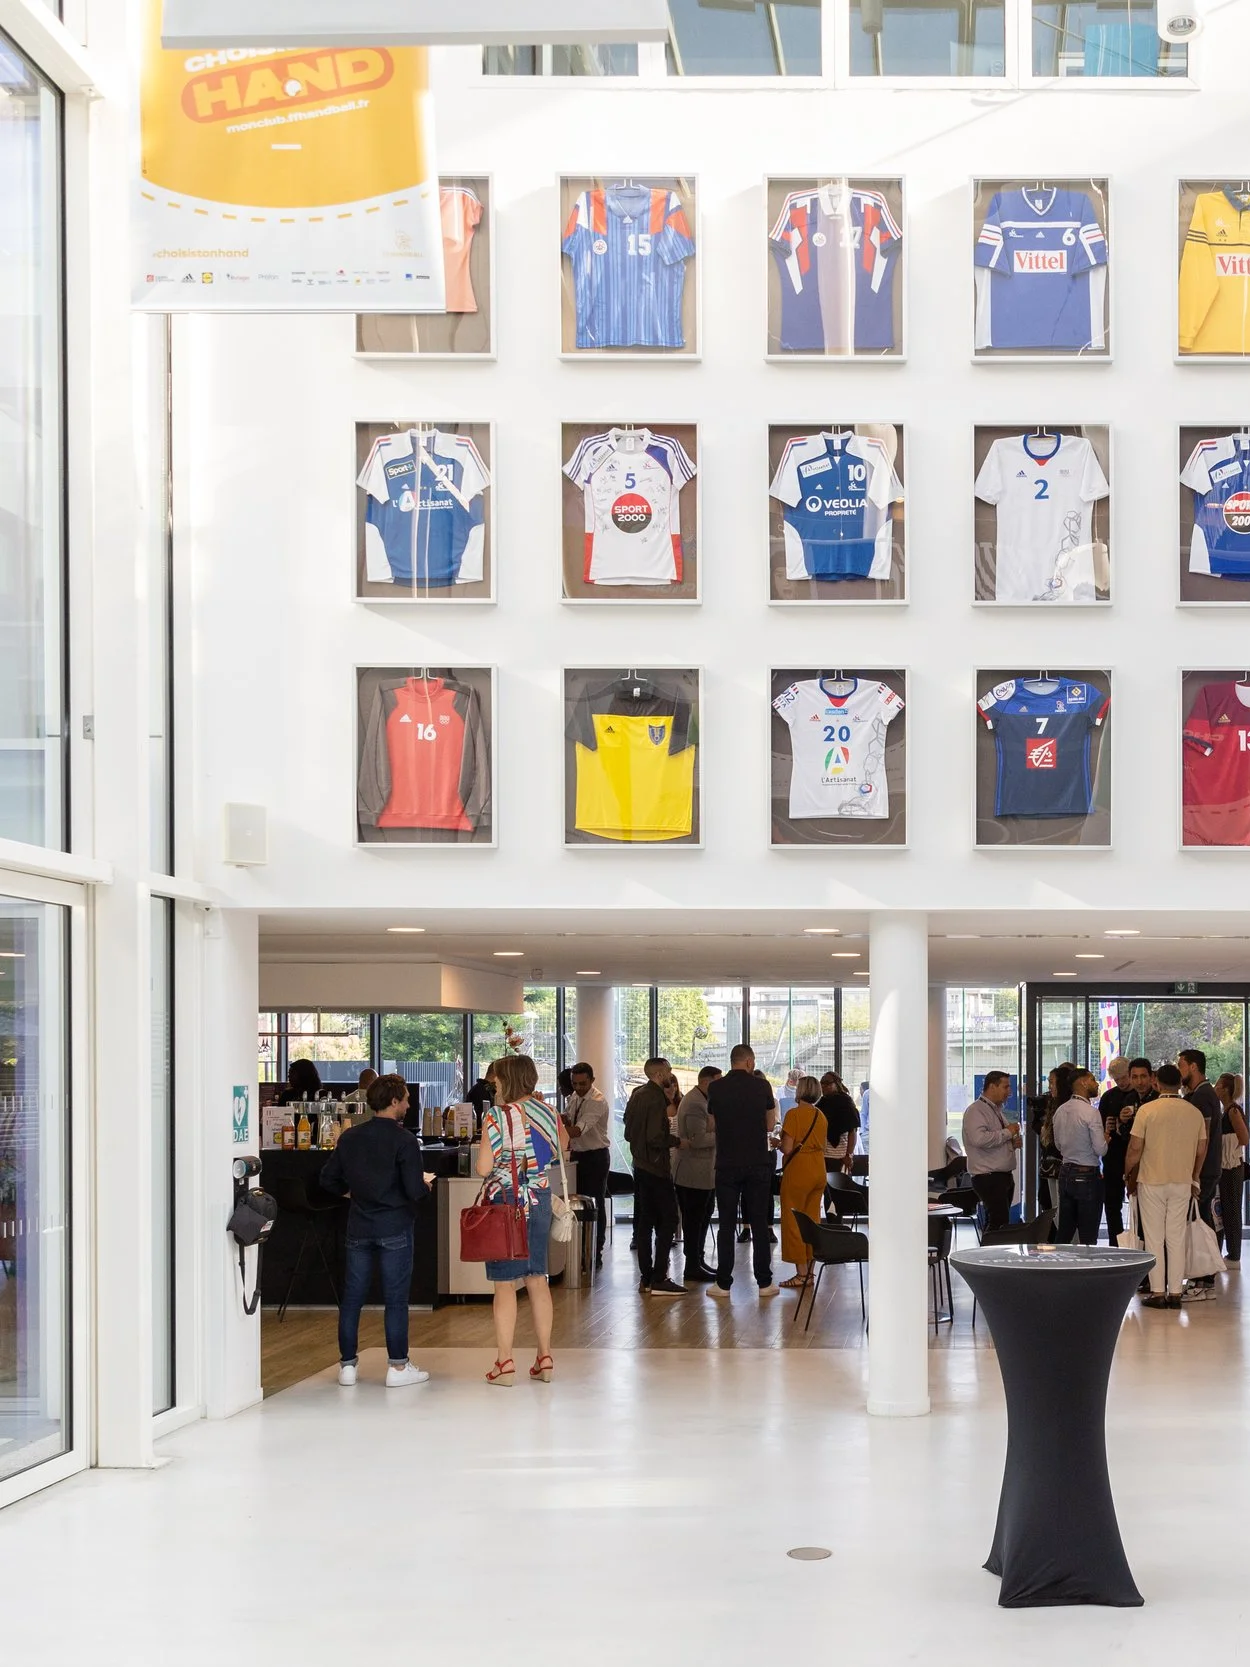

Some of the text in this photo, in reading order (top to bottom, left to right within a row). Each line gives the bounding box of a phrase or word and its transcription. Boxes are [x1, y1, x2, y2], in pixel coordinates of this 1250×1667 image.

[192, 48, 386, 118] HAND
[226, 99, 370, 133] monclub.ffhandball.fr
[628, 234, 651, 256] 15
[1062, 227, 1076, 246] 6
[1016, 253, 1065, 270] Vittel
[435, 464, 453, 481] 21
[624, 472, 637, 490] 5
[848, 464, 867, 482] 10
[1034, 479, 1050, 500] 2
[614, 505, 649, 514] SPORT
[823, 498, 868, 509] VEOLIA
[617, 513, 646, 522] 2000
[417, 723, 437, 741] 16
[823, 725, 851, 742] 20
[1036, 717, 1049, 735] 7
[233, 1128, 249, 1142] DAE
